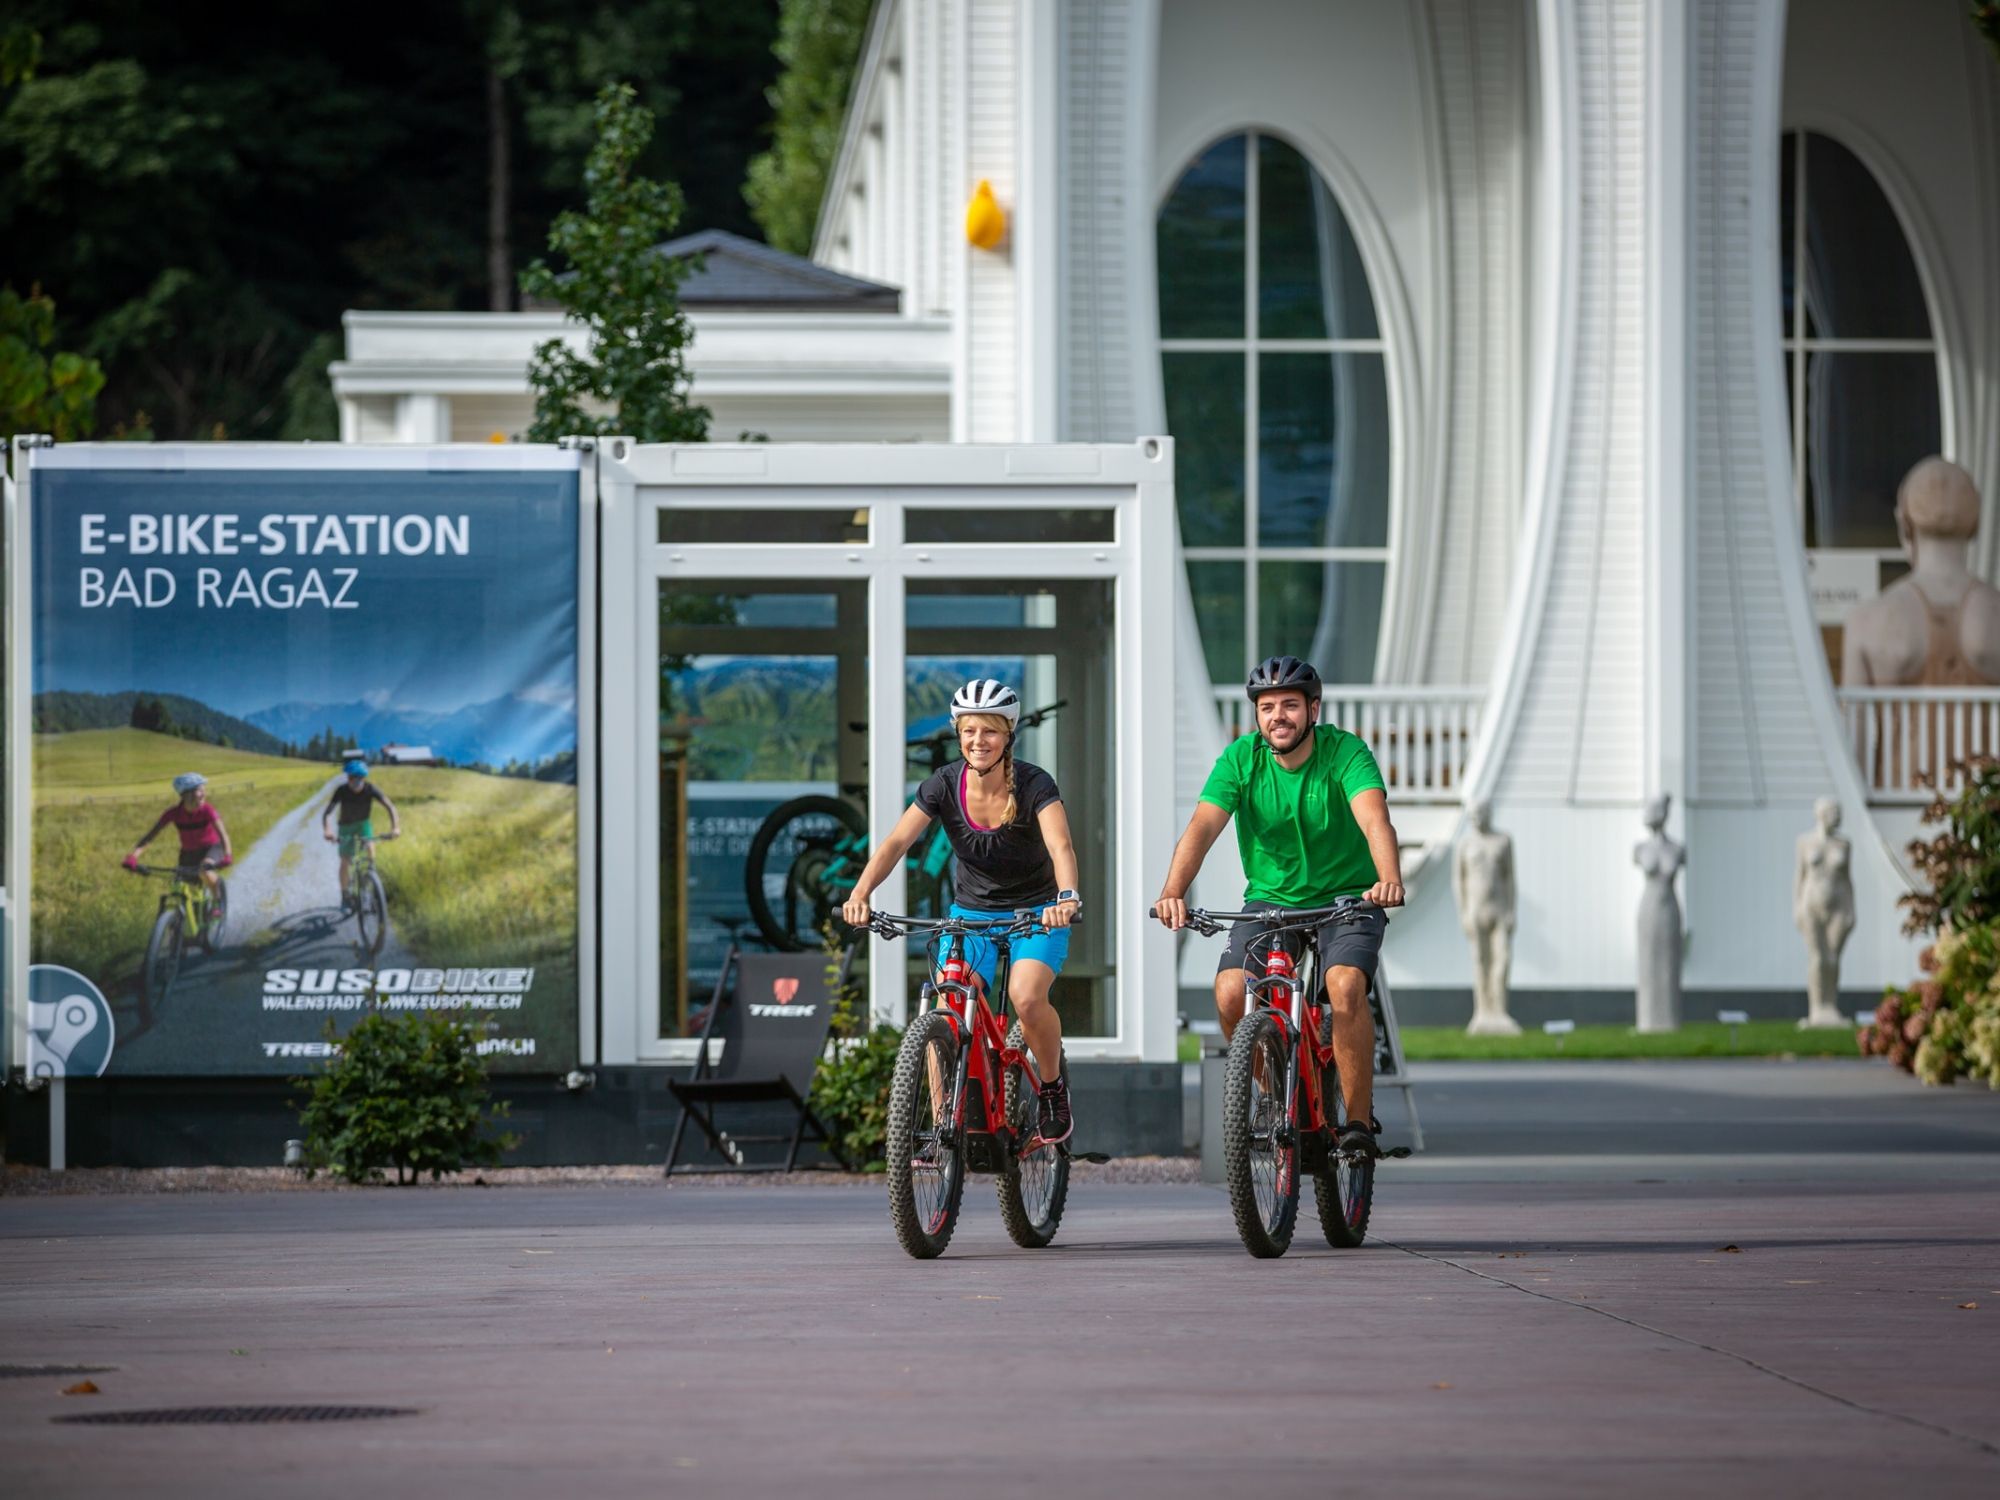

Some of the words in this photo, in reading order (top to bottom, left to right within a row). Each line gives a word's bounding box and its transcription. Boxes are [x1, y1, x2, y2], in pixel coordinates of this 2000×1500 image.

[80, 514, 470, 555] E-BIKE-STATION
[80, 567, 176, 608] BAD
[198, 567, 360, 609] RAGAZ
[262, 968, 533, 994] SUSOBIKE
[262, 995, 364, 1011] WALENSTADT
[749, 1004, 817, 1017] TREK
